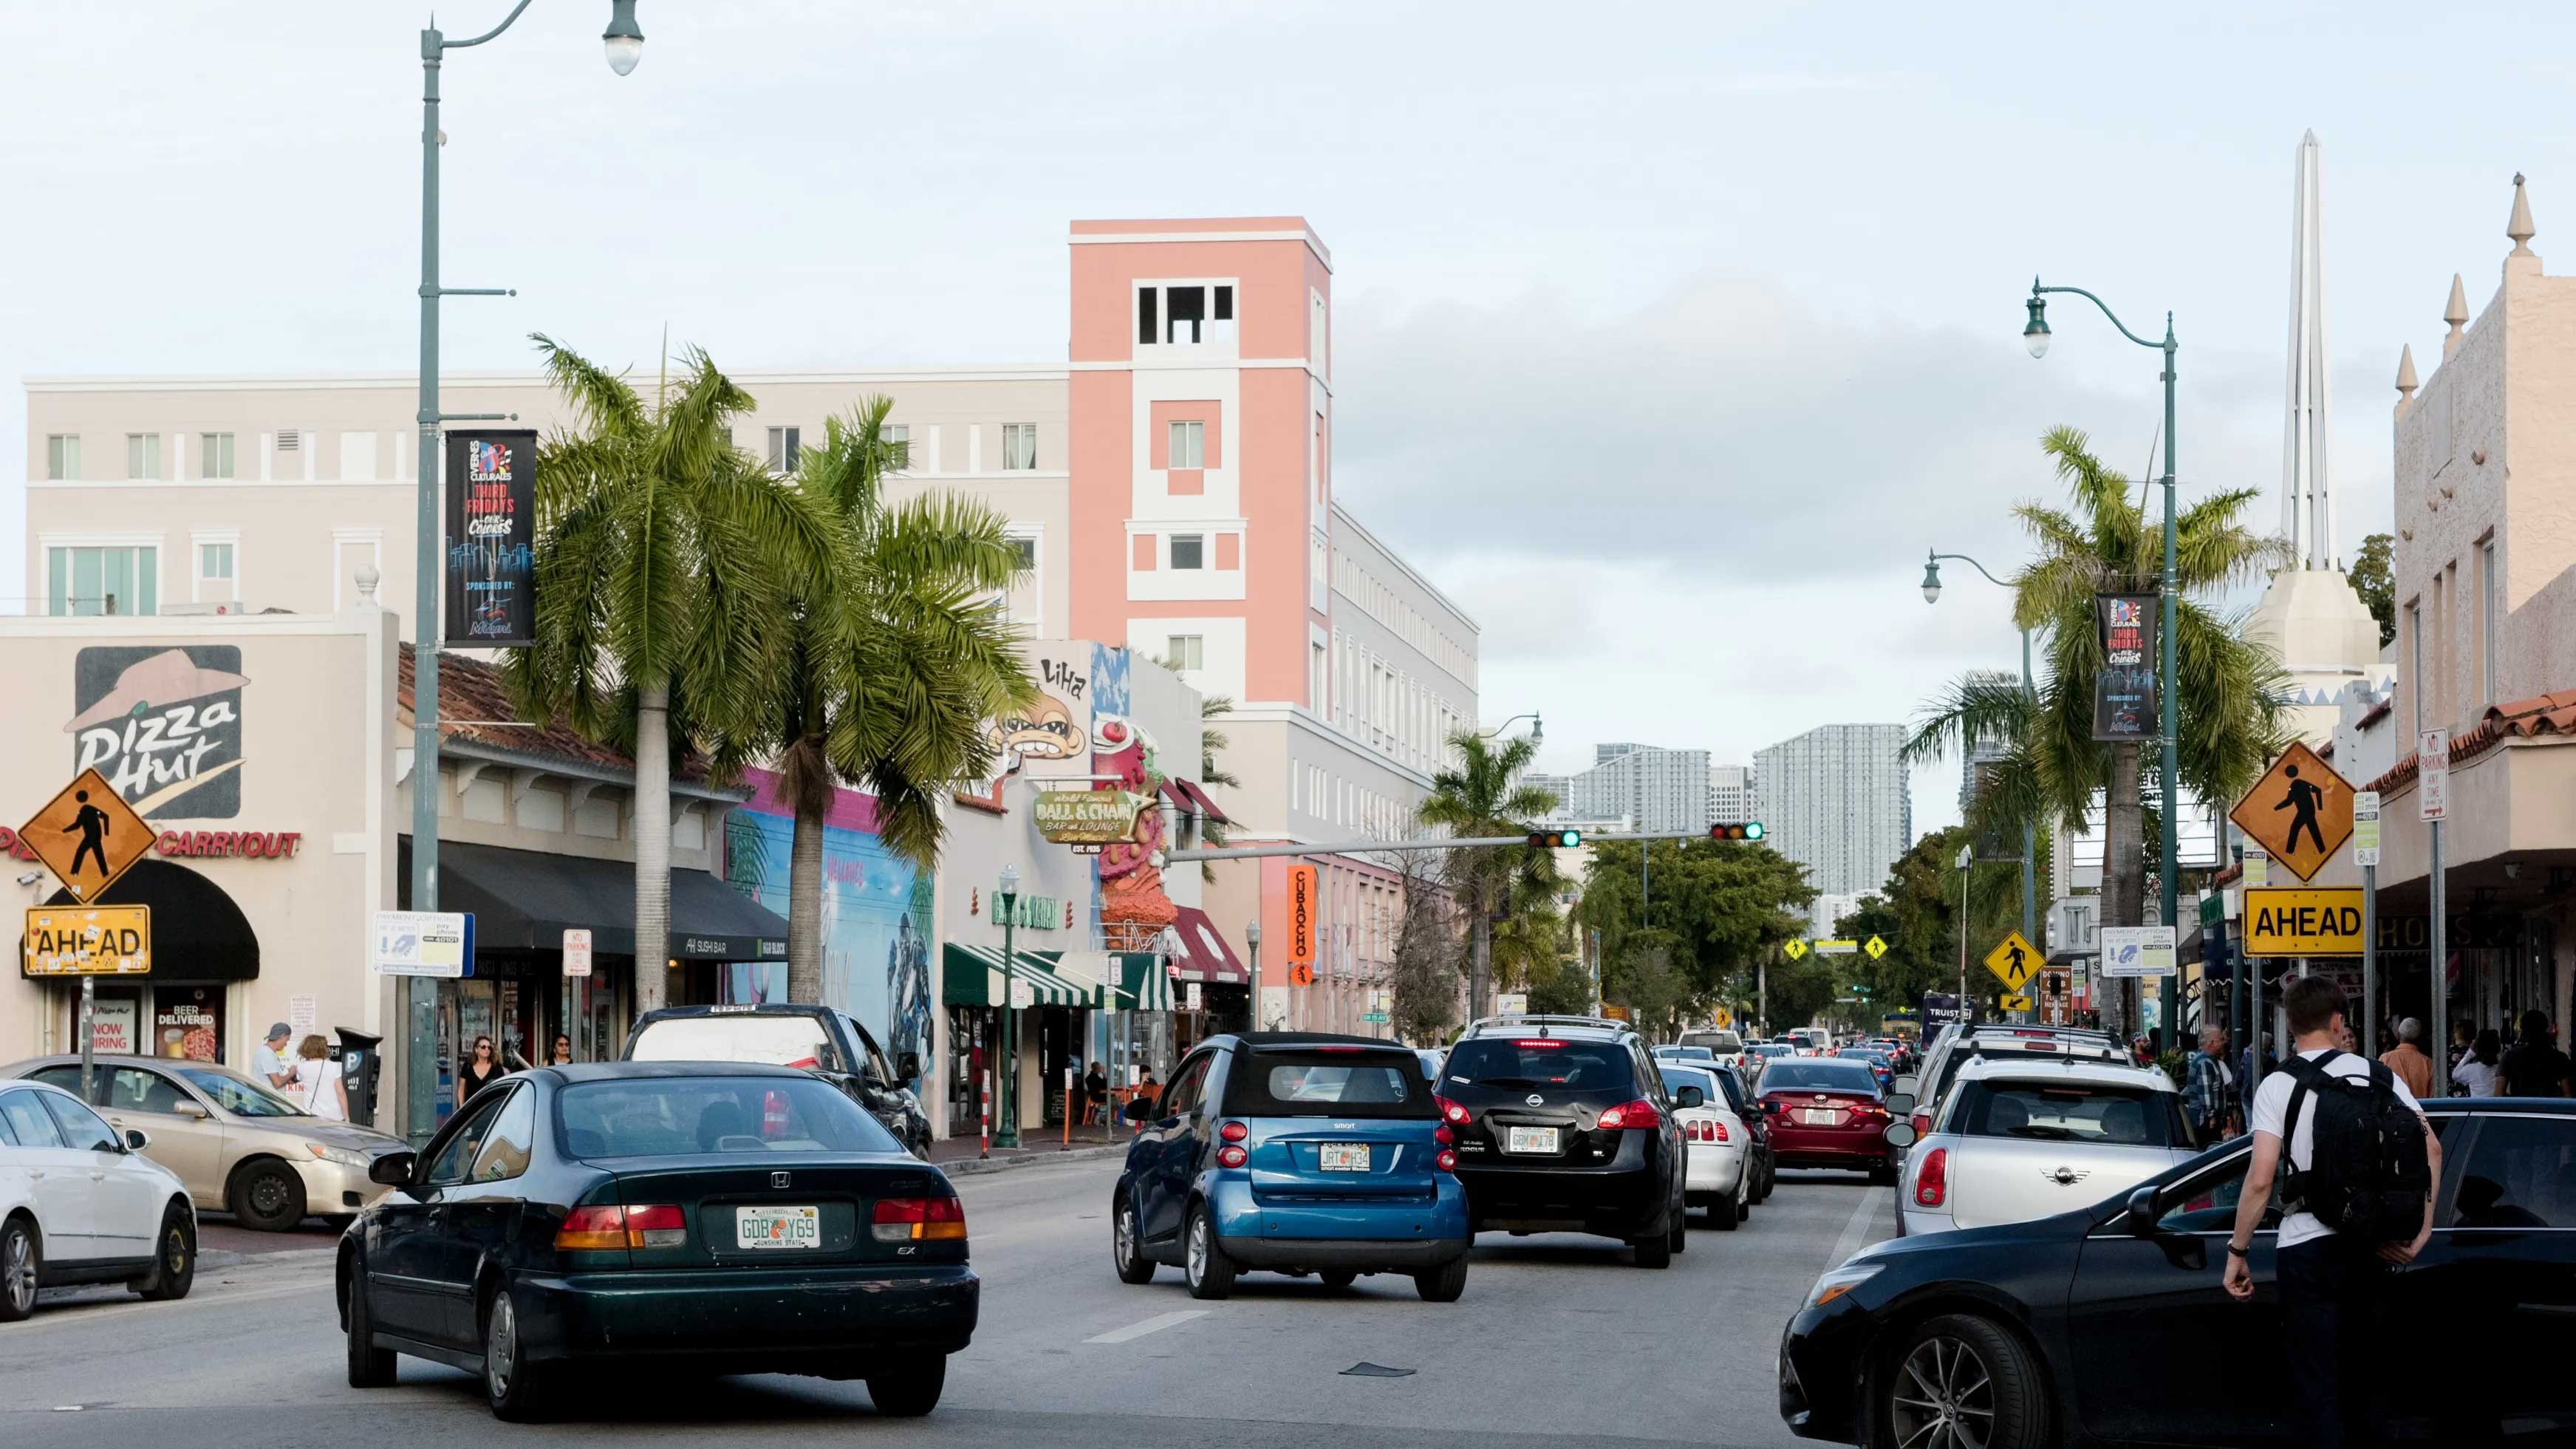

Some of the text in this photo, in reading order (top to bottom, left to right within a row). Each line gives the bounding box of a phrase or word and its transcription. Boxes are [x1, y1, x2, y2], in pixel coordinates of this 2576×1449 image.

[471, 473, 512, 481] CULTURALES
[475, 484, 508, 497] THIRD
[467, 499, 514, 513] FRIDAYS
[466, 582, 502, 590] SPONSORED
[469, 621, 512, 635] Miami
[2114, 629, 2138, 638] THIRD
[2108, 639, 2142, 649] FRIDAYS
[77, 702, 236, 776] Pizza
[2428, 736, 2439, 752] NO
[109, 735, 222, 794] Hut
[2422, 754, 2445, 771] PARKING
[2428, 774, 2439, 783] ANY
[2428, 786, 2439, 798] TIME
[1036, 803, 1131, 820] BALL & CHAIN
[1045, 822, 1067, 831] BAR
[1079, 822, 1122, 831] LOUNGE
[157, 830, 301, 857] CARRYOUT
[1296, 871, 1307, 957] CUBAOCHO
[2255, 907, 2362, 937] AHEAD
[37, 928, 140, 957] AHEAD
[567, 942, 589, 952] PARKING
[697, 940, 714, 953] SUSHI
[714, 942, 726, 954] BAR
[772, 942, 785, 955] BLOCK
[174, 1005, 199, 1015] BEER
[1930, 1009, 1959, 1017] TRUIST
[158, 1015, 214, 1026] DELIVERED
[93, 1023, 123, 1034] NOW
[1323, 1151, 1369, 1165] JRT H34
[742, 1218, 815, 1239] GDB Y69
[898, 1247, 916, 1255] EX
